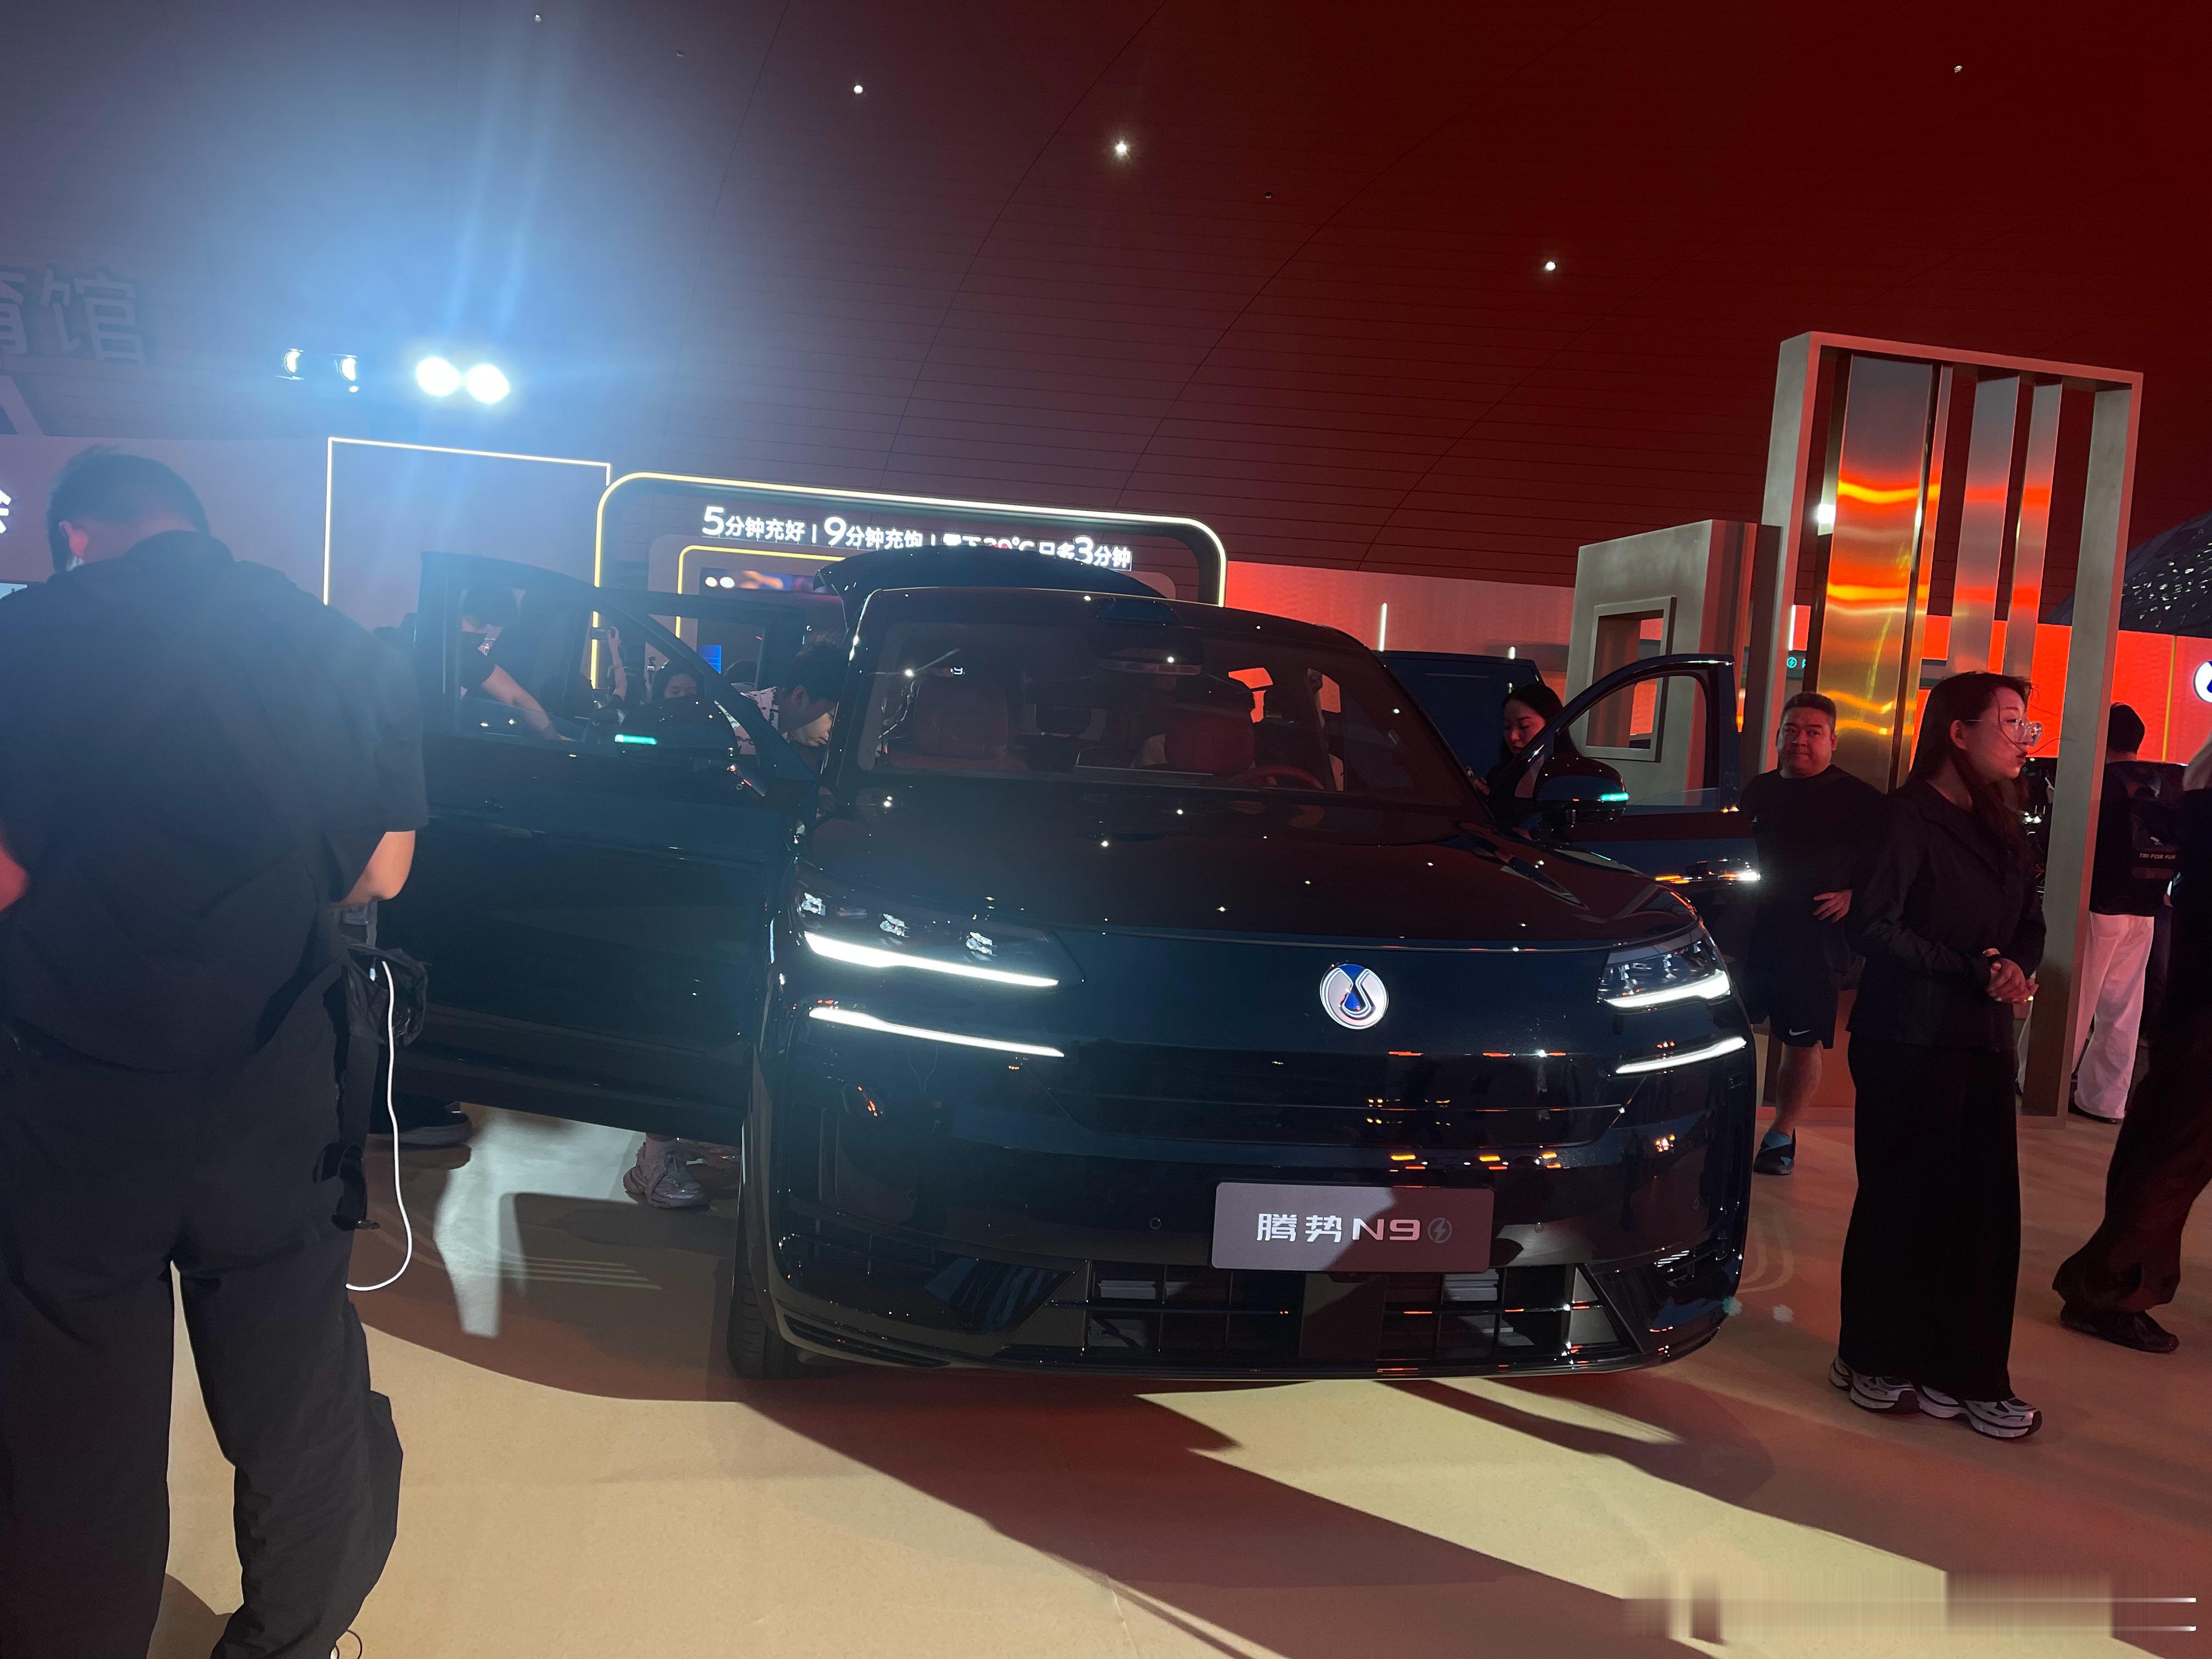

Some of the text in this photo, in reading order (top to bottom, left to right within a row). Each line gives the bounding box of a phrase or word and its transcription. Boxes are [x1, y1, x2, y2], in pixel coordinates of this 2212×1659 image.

[702, 505, 805, 541] 5分钟充好
[1256, 1213, 1421, 1243] 腾势 N9
